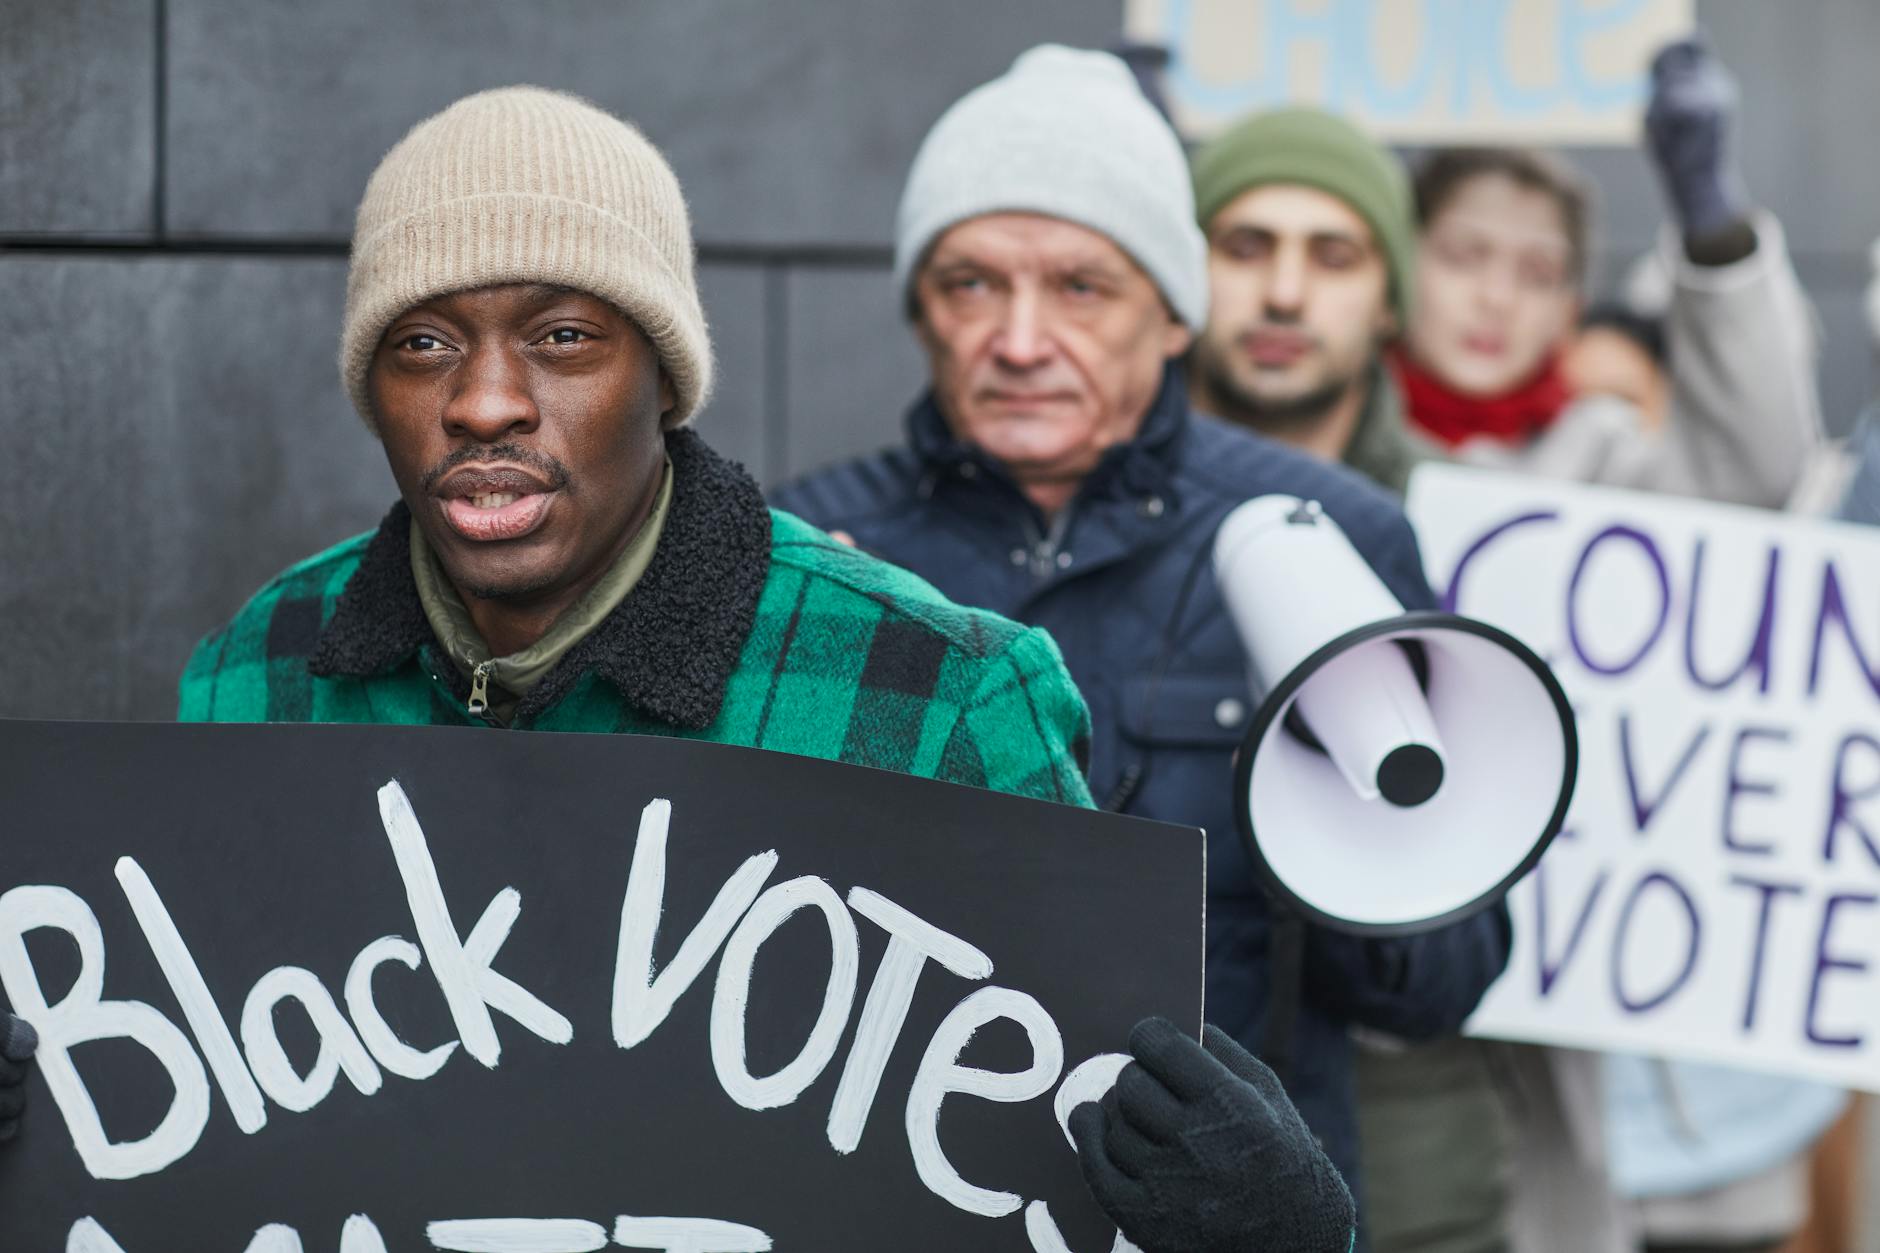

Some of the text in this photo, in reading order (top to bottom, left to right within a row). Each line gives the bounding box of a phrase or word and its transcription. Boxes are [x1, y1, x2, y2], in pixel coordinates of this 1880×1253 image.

[1553, 702, 1880, 870] VER
[0, 777, 574, 1180] Black
[1534, 864, 1880, 1048] VOTE
